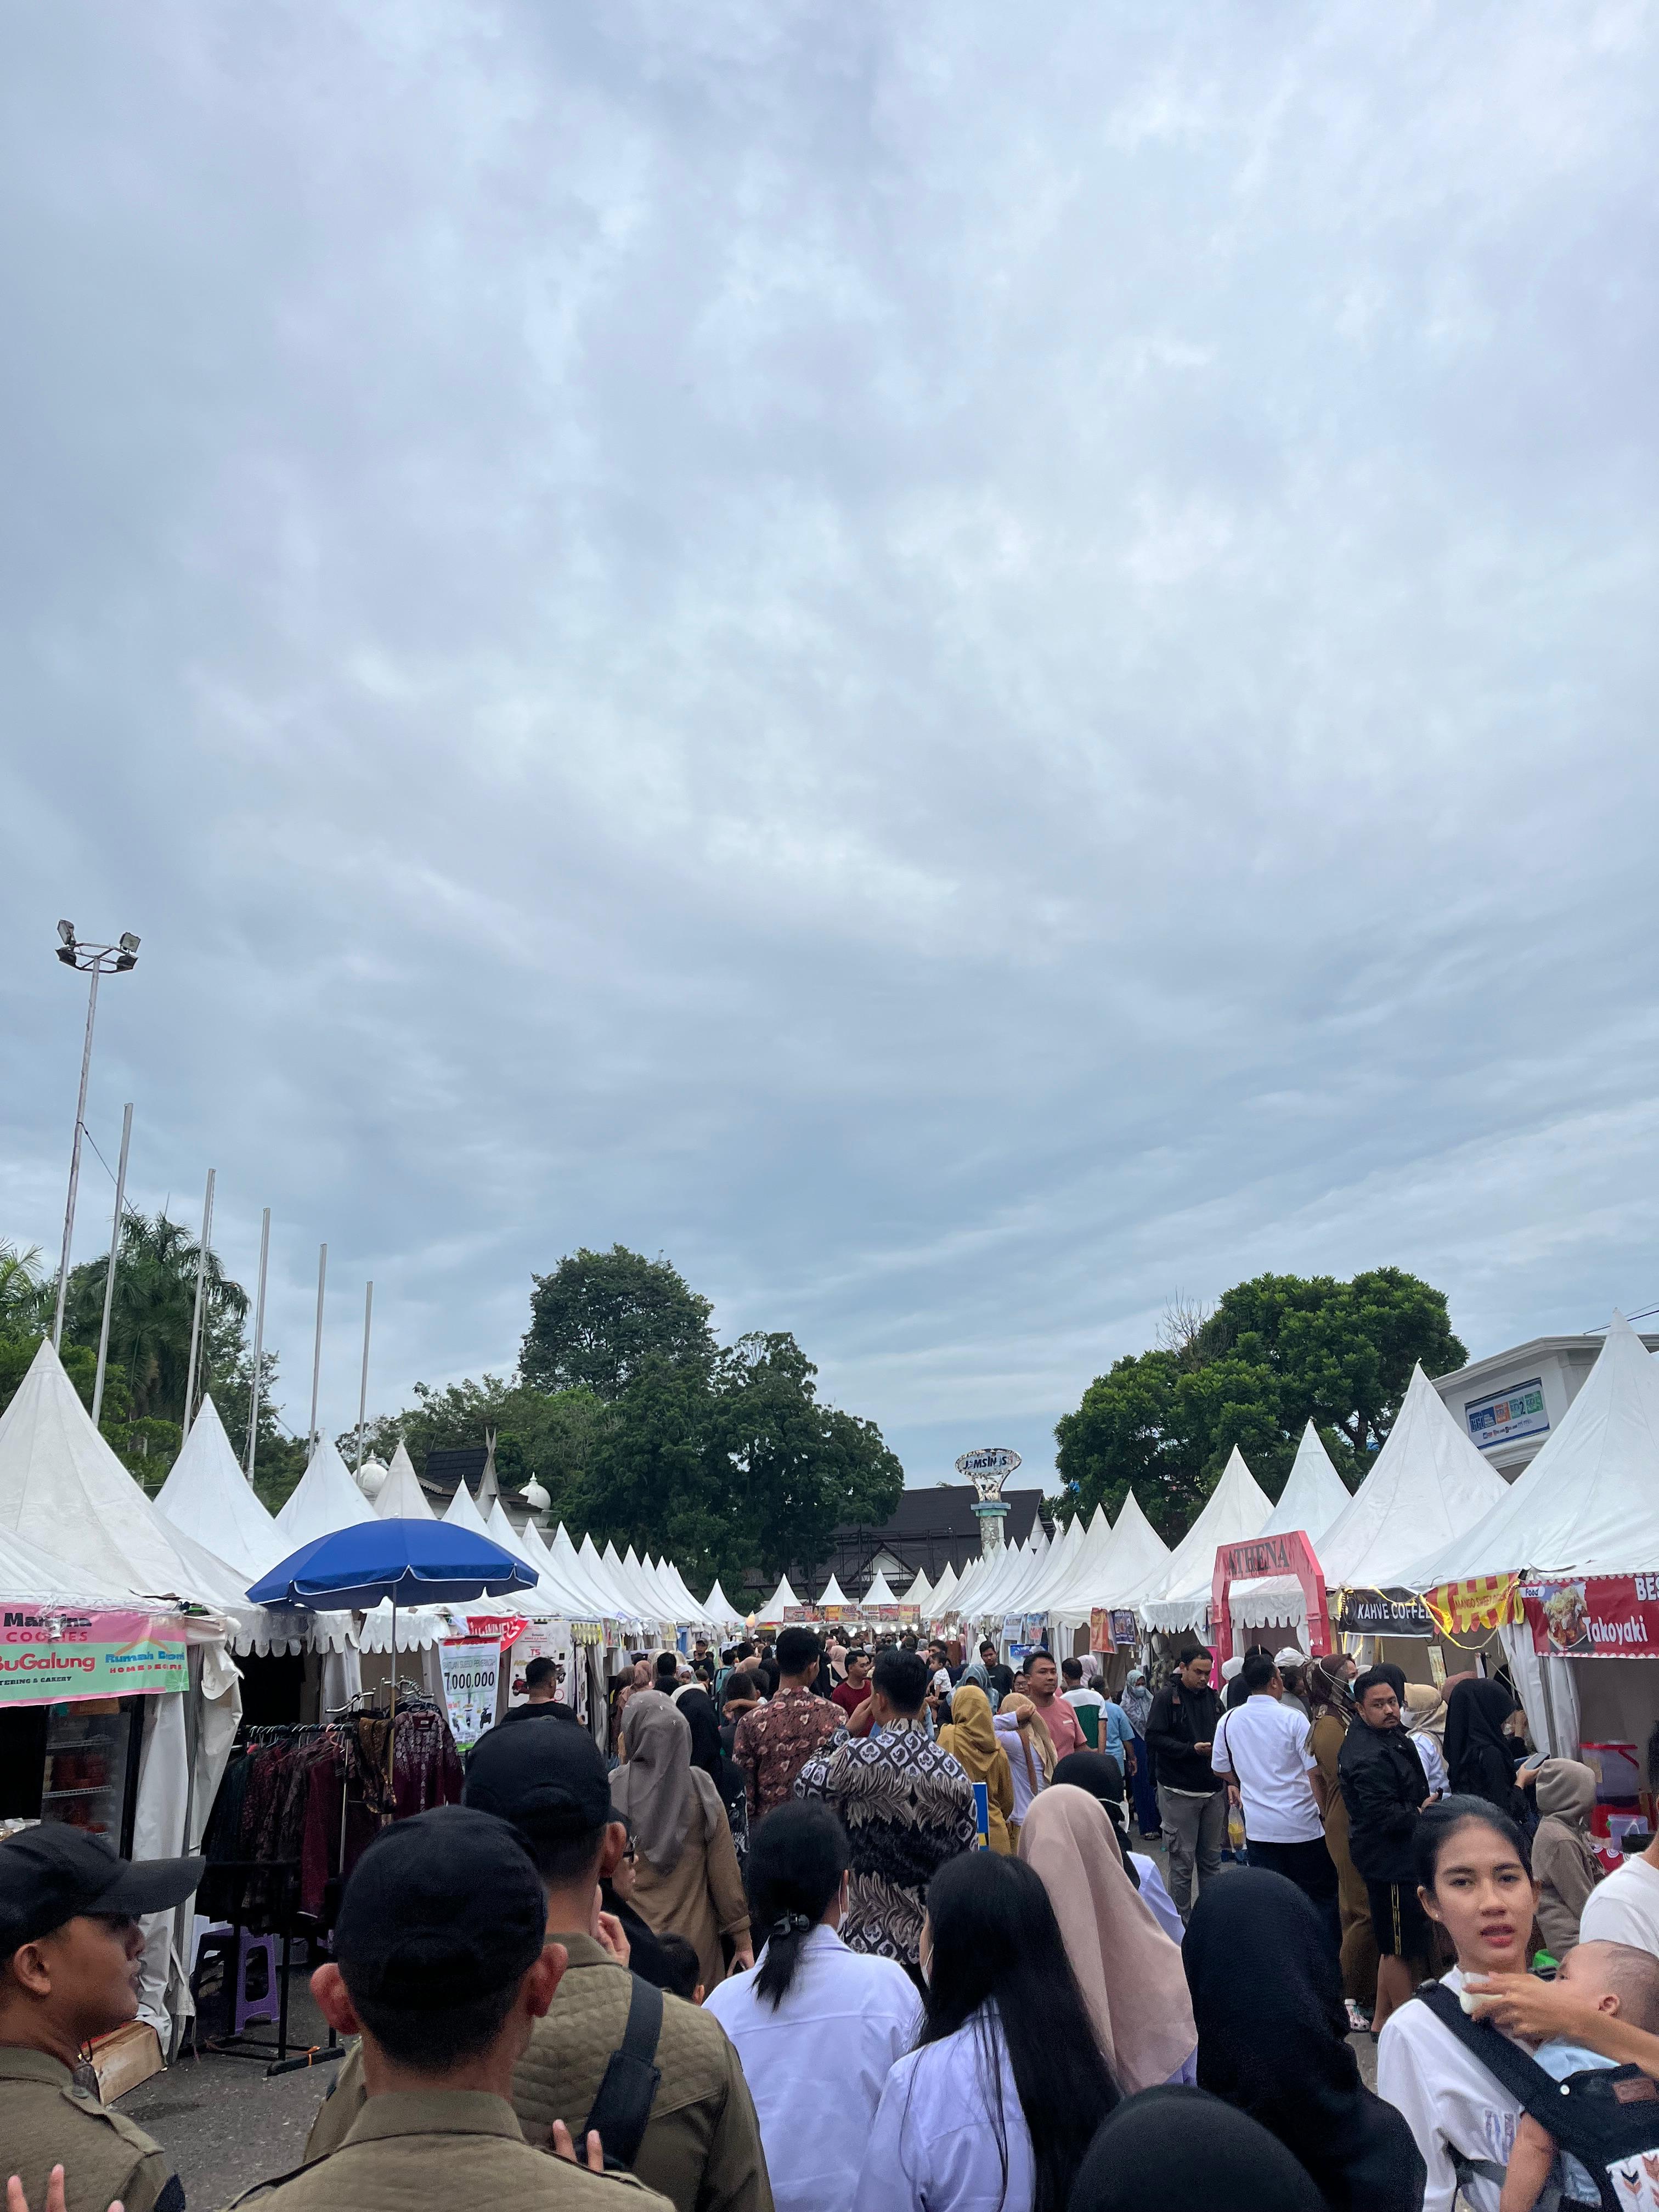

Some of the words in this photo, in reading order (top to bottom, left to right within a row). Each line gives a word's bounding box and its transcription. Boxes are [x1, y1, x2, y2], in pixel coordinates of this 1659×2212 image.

[1228, 1538, 1290, 1576] ATHENA
[1357, 1602, 1390, 1620] KAHVE
[5, 1632, 88, 1642] COOIES
[1582, 1615, 1648, 1645] Takoyaki
